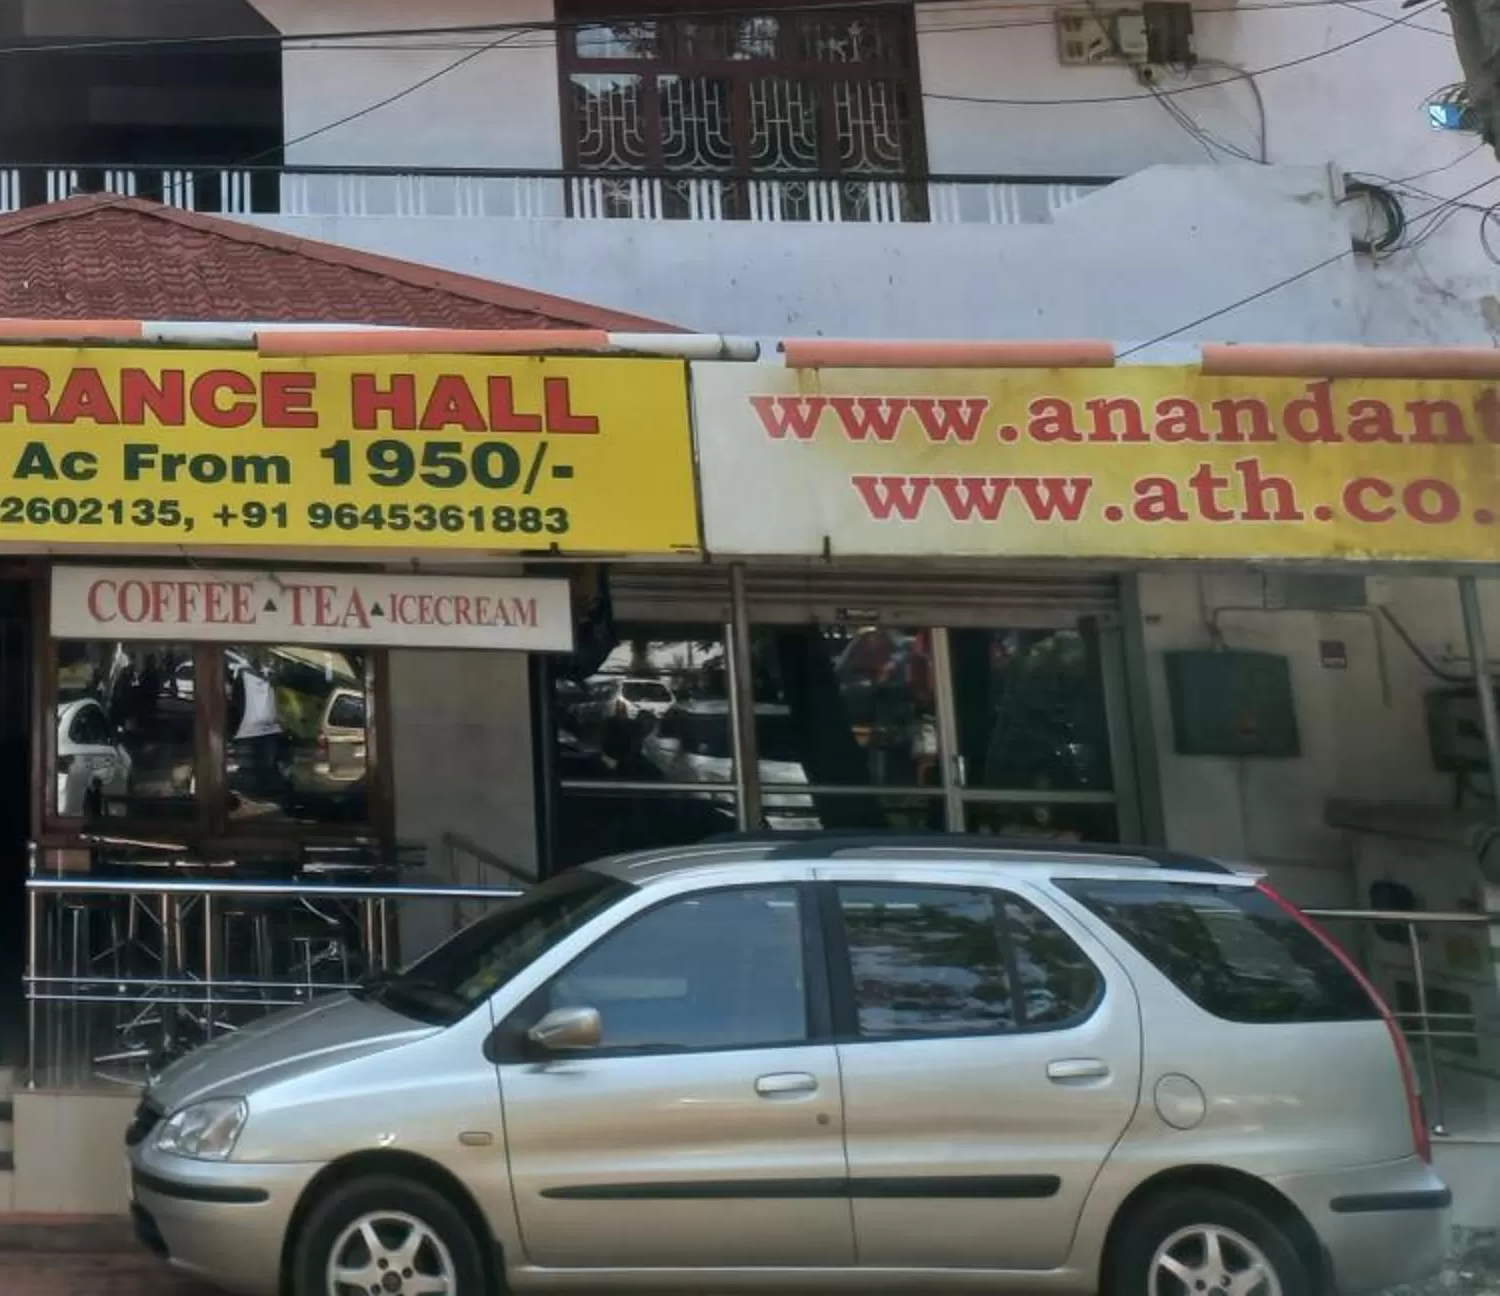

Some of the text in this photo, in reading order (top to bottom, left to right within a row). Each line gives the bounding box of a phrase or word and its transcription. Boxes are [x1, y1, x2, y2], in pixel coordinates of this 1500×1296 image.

[351, 372, 600, 435] HALL
[13, 442, 99, 481] Ac
[124, 443, 291, 485] From
[320, 438, 575, 495] 1950/-
[307, 503, 570, 534] 9645361883
[87, 579, 539, 629] COFFEE TEA ICECREAM
